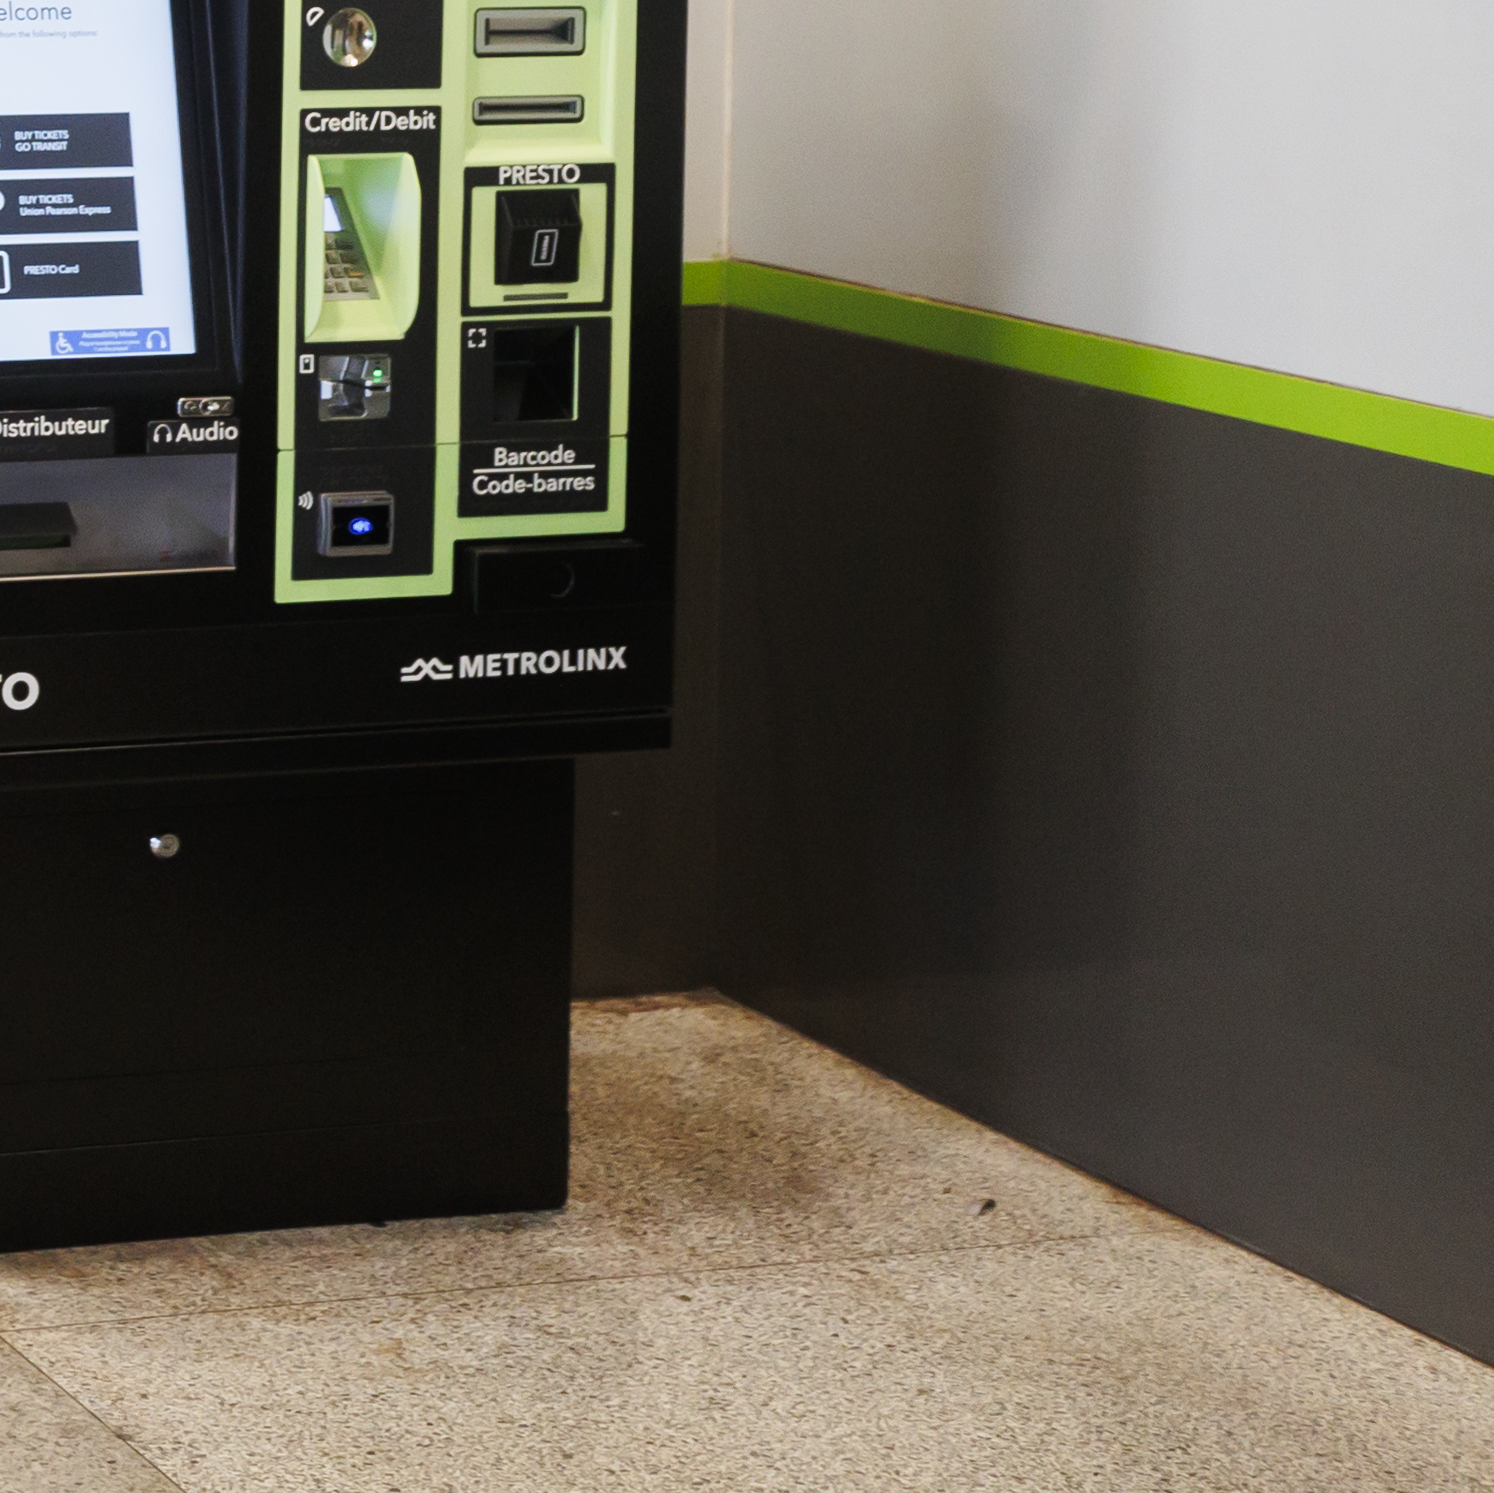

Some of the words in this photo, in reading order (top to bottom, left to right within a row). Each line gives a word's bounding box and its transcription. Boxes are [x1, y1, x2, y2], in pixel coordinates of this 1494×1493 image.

[304, 109, 436, 133] Credit/Debit
[15, 142, 31, 152] GO
[498, 164, 580, 185] PRESTO
[23, 265, 59, 275] PRESTO
[175, 420, 239, 443] Audio
[493, 444, 576, 466] Barcode
[472, 473, 596, 495] Code-barres
[458, 646, 627, 679] METROLINX
